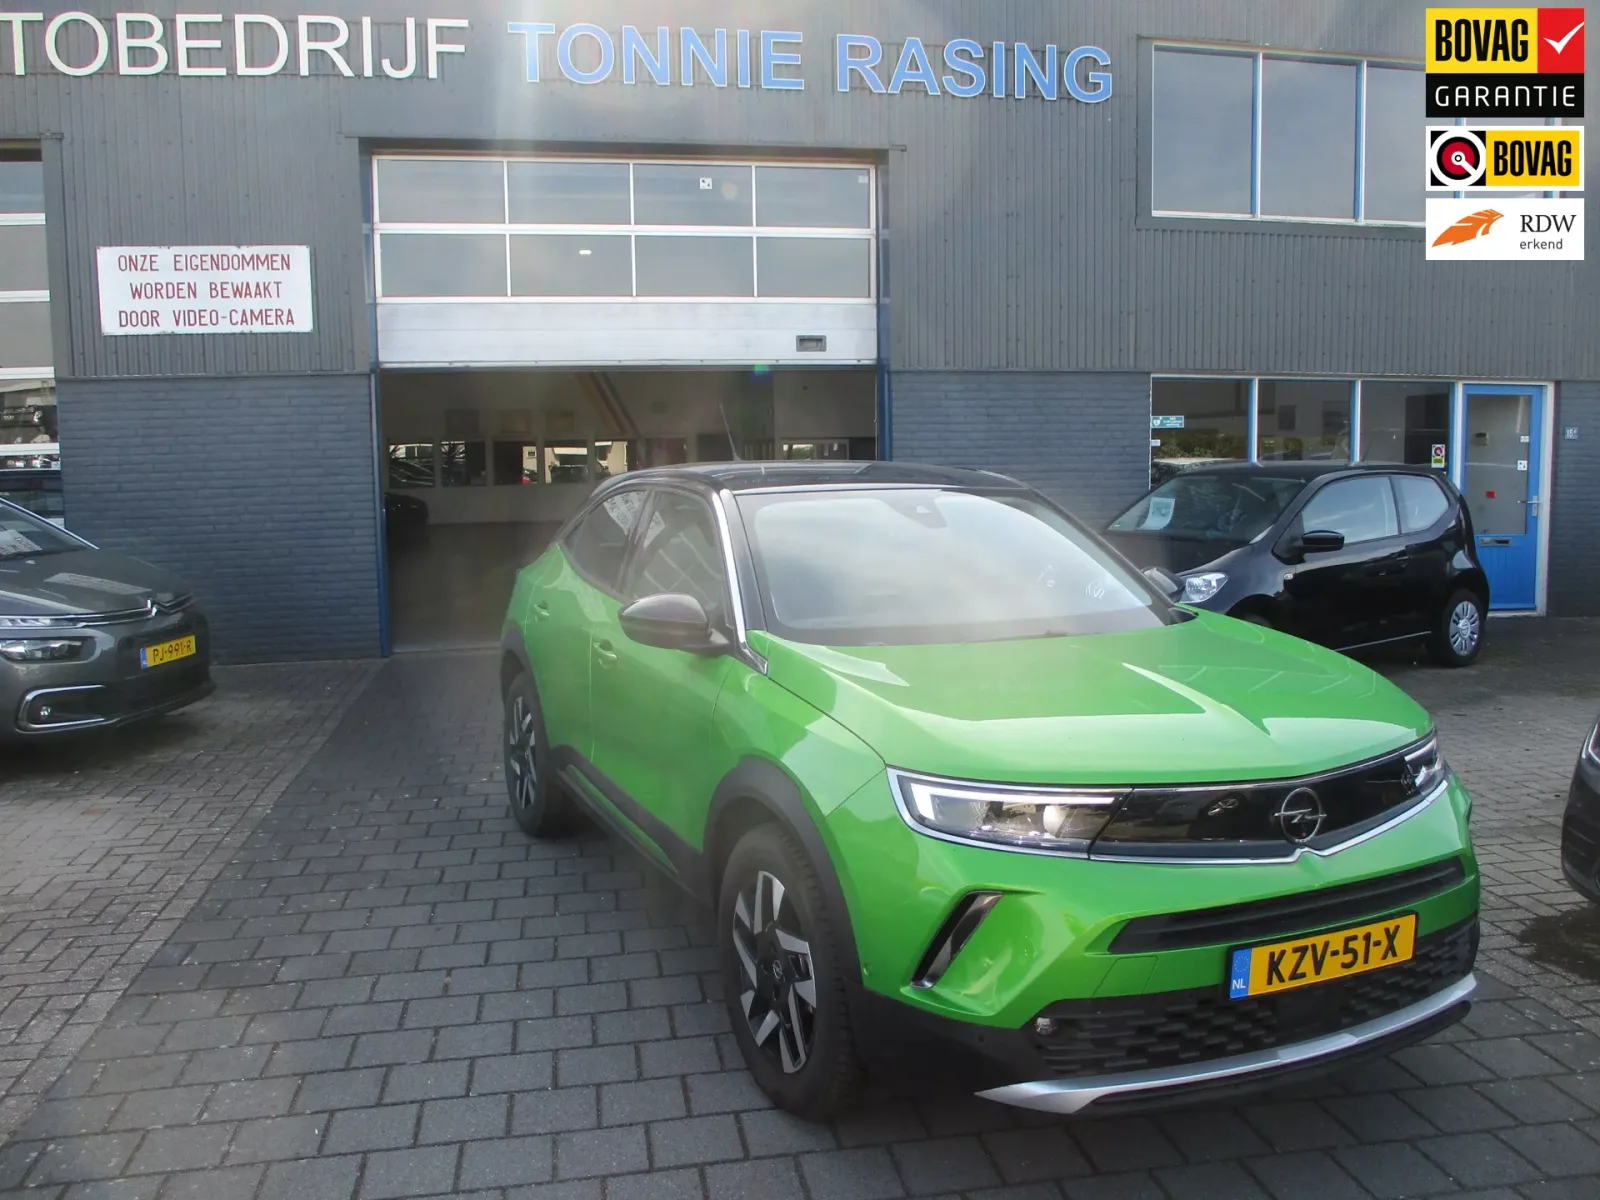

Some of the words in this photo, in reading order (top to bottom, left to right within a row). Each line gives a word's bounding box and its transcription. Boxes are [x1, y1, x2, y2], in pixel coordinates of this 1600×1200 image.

[507, 21, 805, 91] TONNIE
[836, 33, 1113, 104] RASING
[117, 254, 160, 272] ONZE
[173, 253, 291, 271] EIGENDOMMEN
[129, 282, 198, 300] WORDEN
[209, 281, 283, 299] BEWAAKT
[118, 310, 161, 328] DOOR
[172, 308, 295, 328] VIDEO-CAMERA
[1265, 923, 1402, 986] KZV-51-X
[1232, 978, 1246, 990] NL
